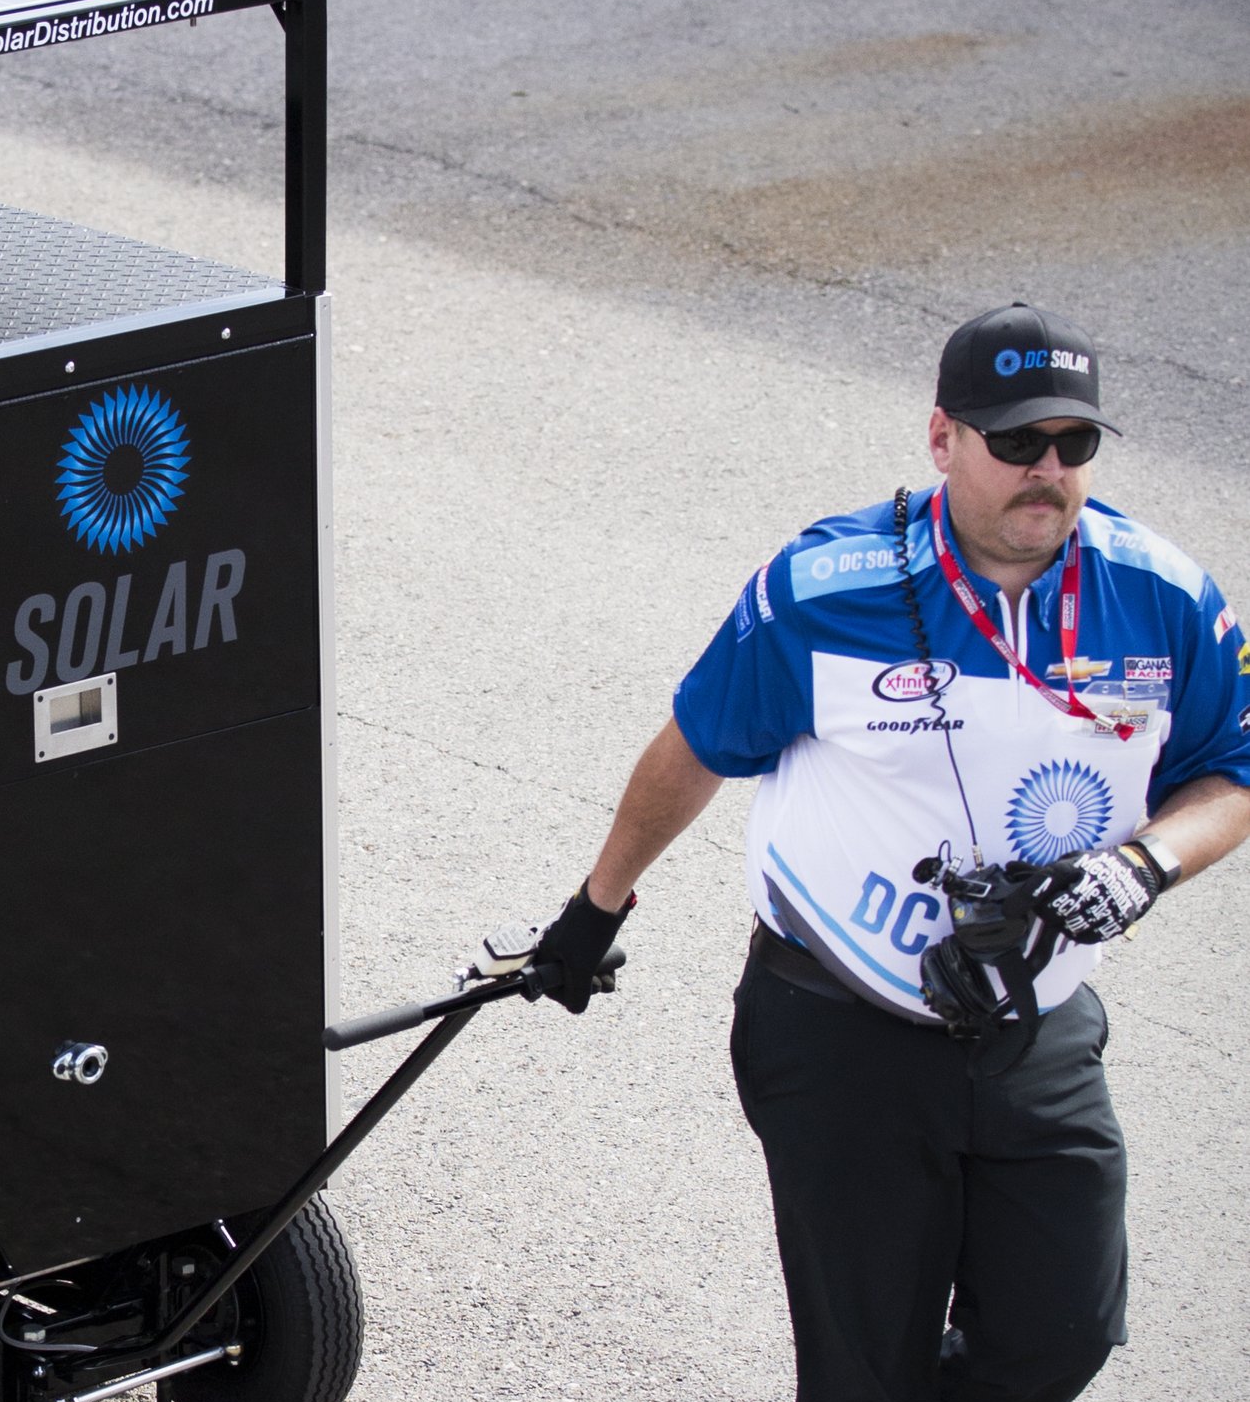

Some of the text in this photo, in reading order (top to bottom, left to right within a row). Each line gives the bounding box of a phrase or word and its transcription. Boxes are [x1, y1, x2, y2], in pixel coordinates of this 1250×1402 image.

[1024, 349, 1089, 375] DC SOLAR
[838, 550, 863, 573] DC
[5, 548, 247, 696] SOLAR
[867, 717, 964, 735] GOODYEAR
[849, 870, 941, 956] DC
